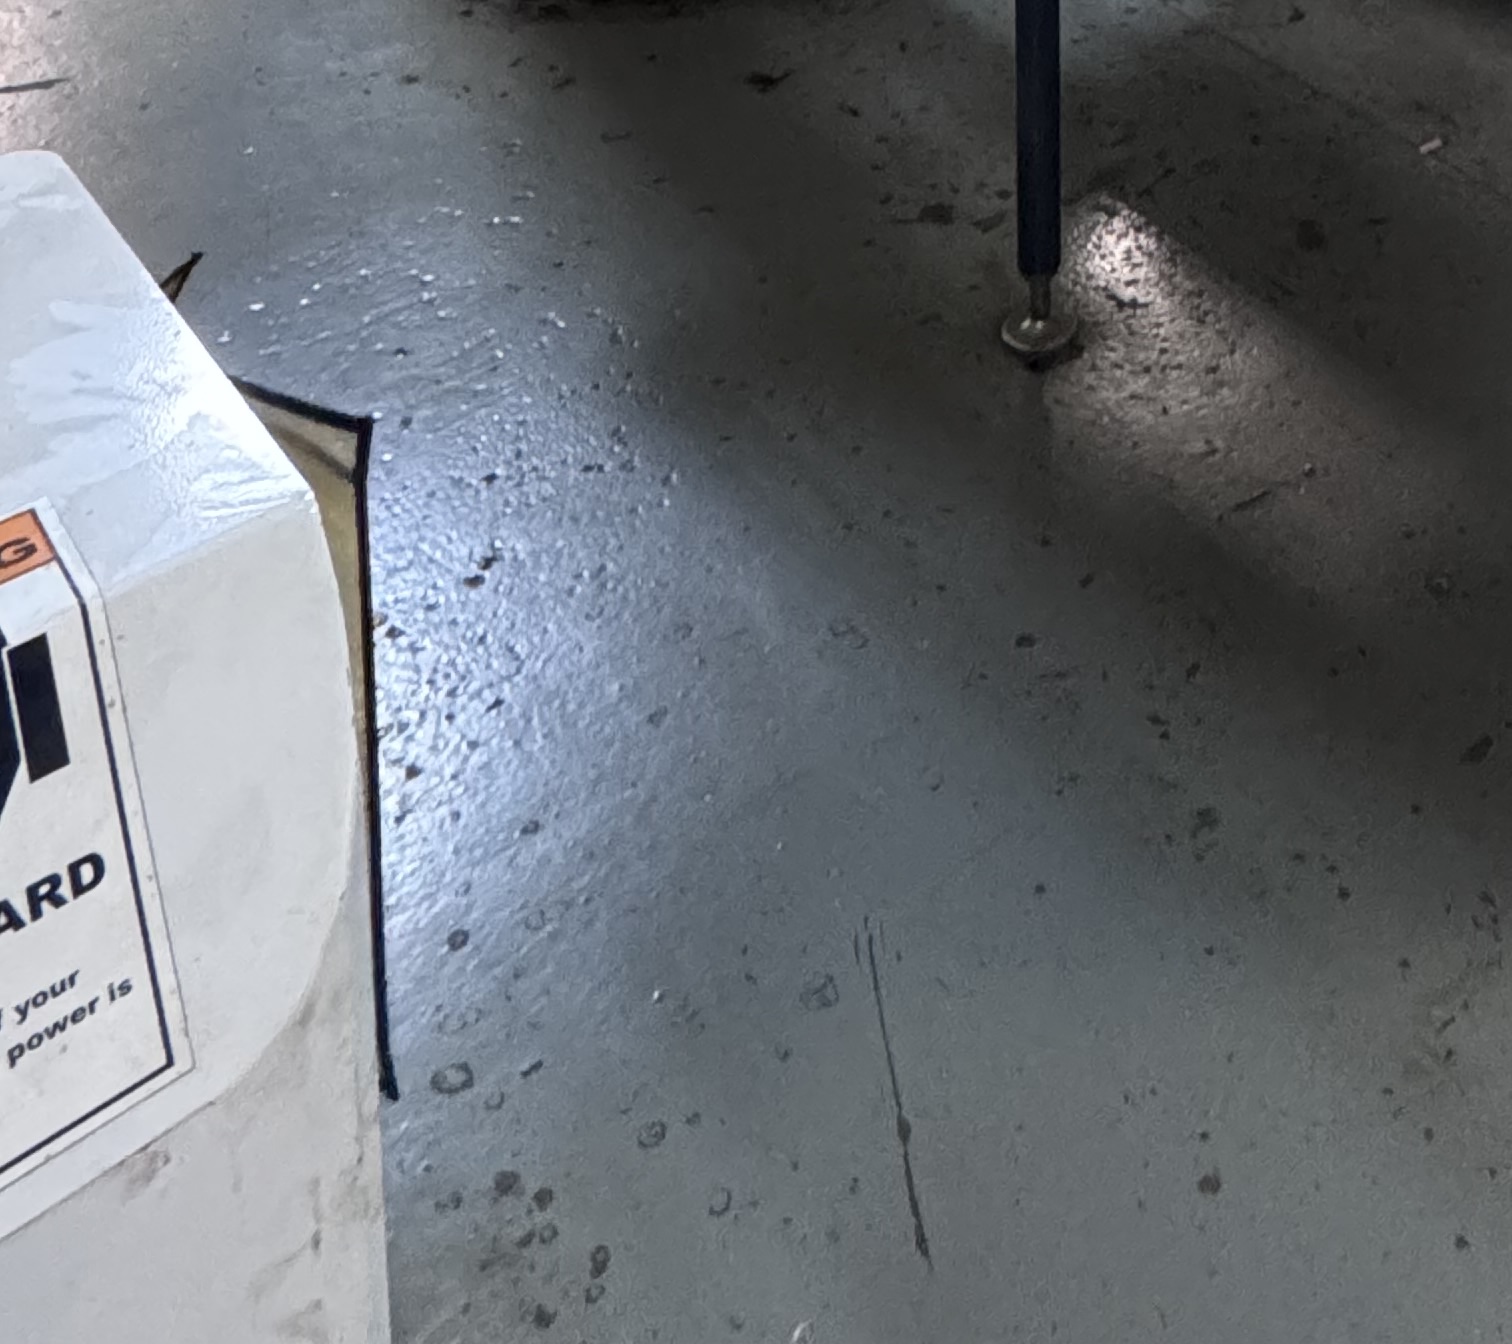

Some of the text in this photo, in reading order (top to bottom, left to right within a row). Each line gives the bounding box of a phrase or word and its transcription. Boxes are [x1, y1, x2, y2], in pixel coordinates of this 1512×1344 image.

[6, 996, 101, 1070] power
[107, 976, 134, 1005] is
[14, 968, 81, 1025] your
